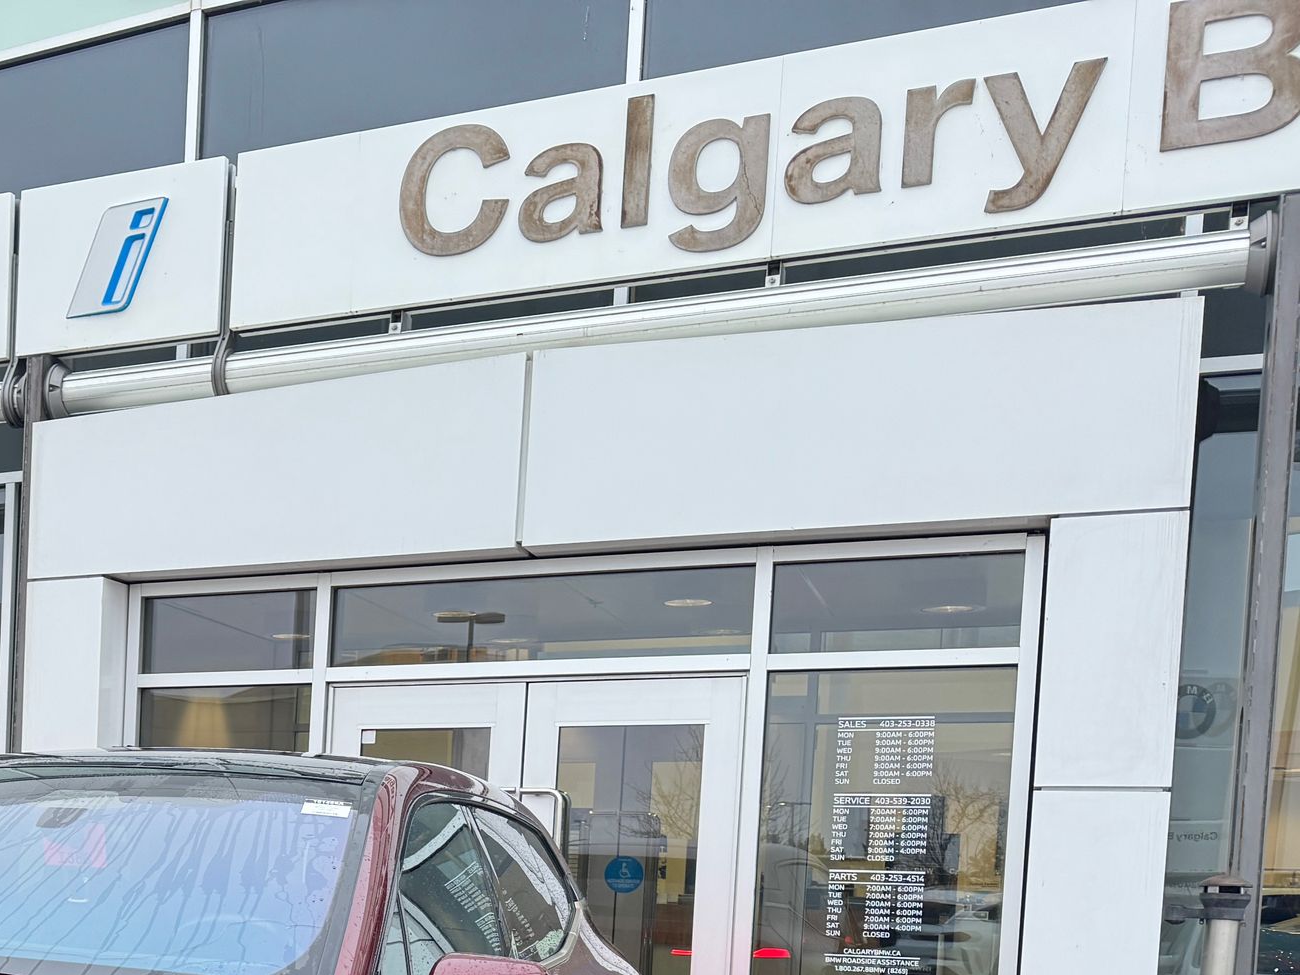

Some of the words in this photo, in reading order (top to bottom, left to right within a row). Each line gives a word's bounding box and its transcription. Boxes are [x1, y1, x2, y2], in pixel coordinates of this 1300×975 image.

[399, 57, 1108, 257] Calgary
[1160, 0, 1300, 152] B
[833, 797, 870, 805] SERVICE
[829, 873, 857, 881] PARTS
[843, 948, 901, 956] CALGARYBMW.CA
[876, 959, 920, 967] ASSISTANCE
